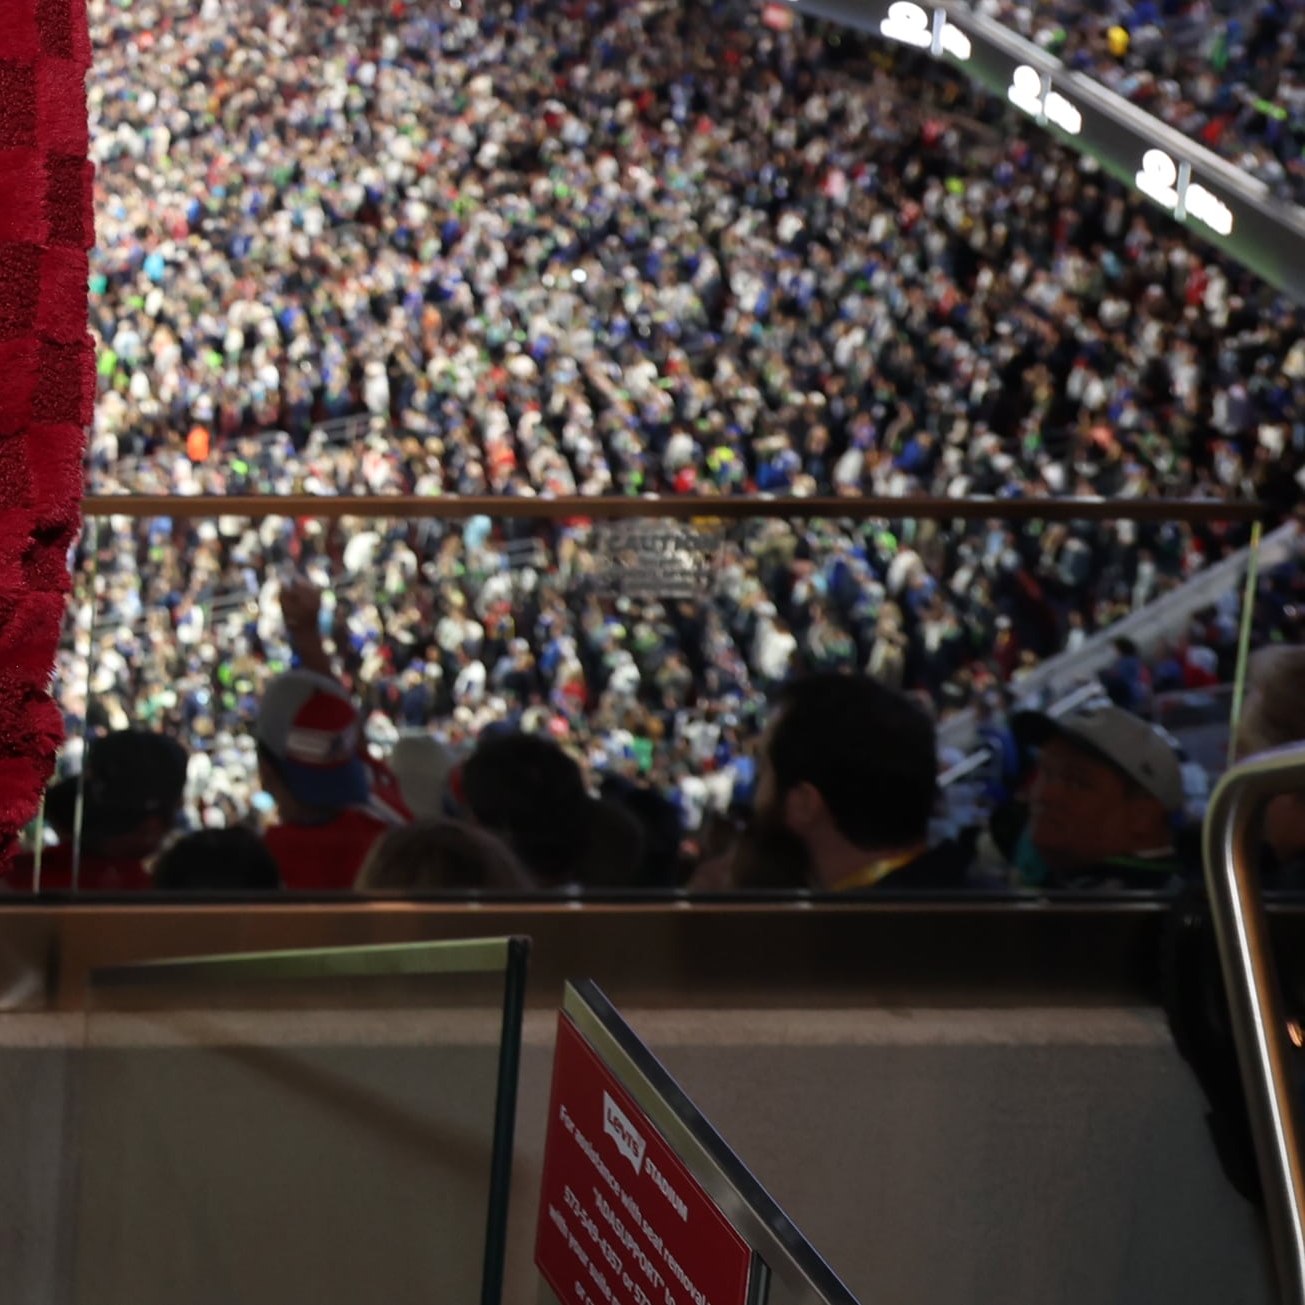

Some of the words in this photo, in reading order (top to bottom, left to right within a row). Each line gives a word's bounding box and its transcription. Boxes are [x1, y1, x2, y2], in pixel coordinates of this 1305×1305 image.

[559, 1103, 575, 1134] For
[574, 1127, 621, 1196] assistance
[621, 1188, 642, 1226] with
[642, 1219, 663, 1256] seat
[645, 1156, 688, 1223] STADIUM
